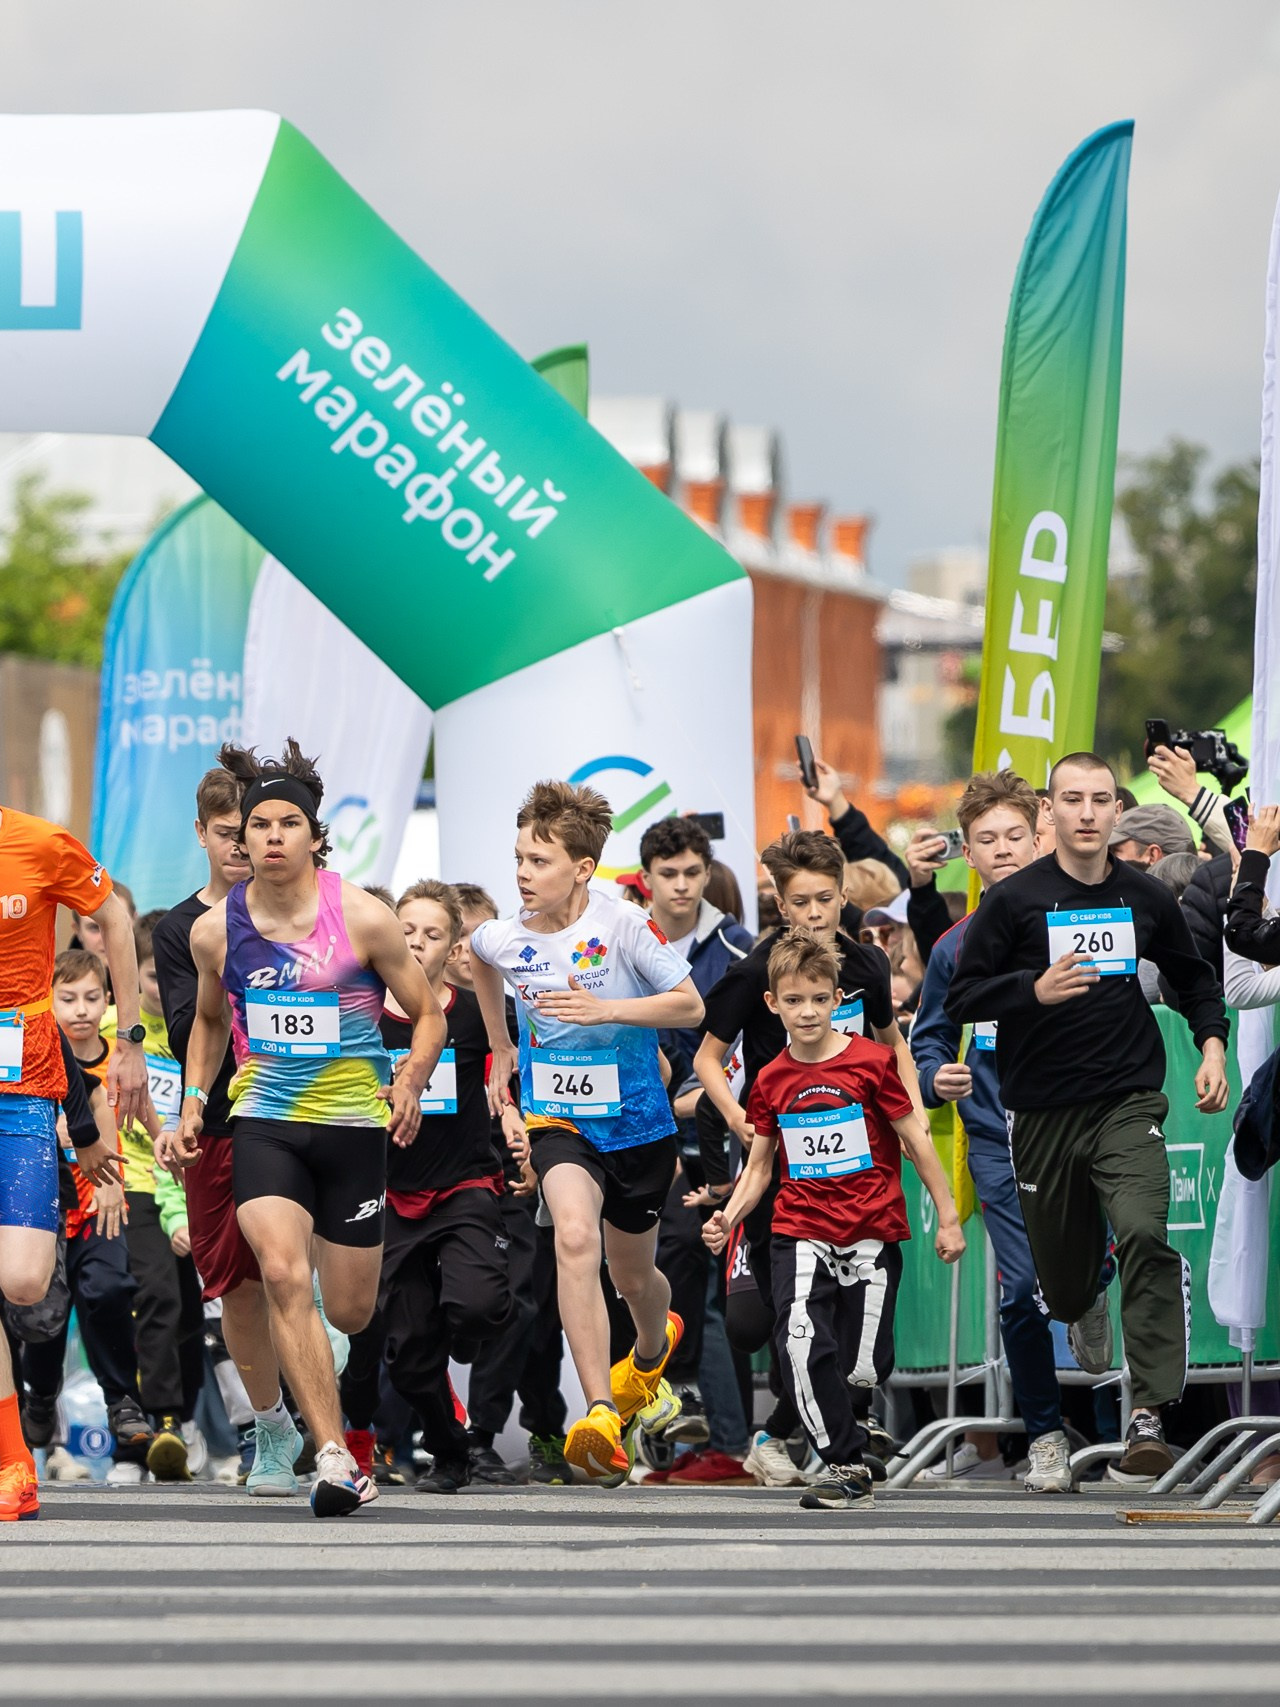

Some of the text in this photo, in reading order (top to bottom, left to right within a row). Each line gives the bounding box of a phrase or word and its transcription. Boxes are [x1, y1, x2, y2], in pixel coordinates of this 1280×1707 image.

[321, 306, 567, 540] зелёный
[275, 347, 517, 583] марафон
[997, 510, 1068, 772] БЕР
[122, 657, 242, 705] зелён
[0, 894, 28, 920] 10
[1073, 930, 1114, 954] 260
[276, 995, 296, 1003] СБЕР
[270, 1013, 315, 1036] 183
[150, 1076, 174, 1097] 72
[552, 1072, 594, 1096] 246
[802, 1132, 846, 1157] 342
